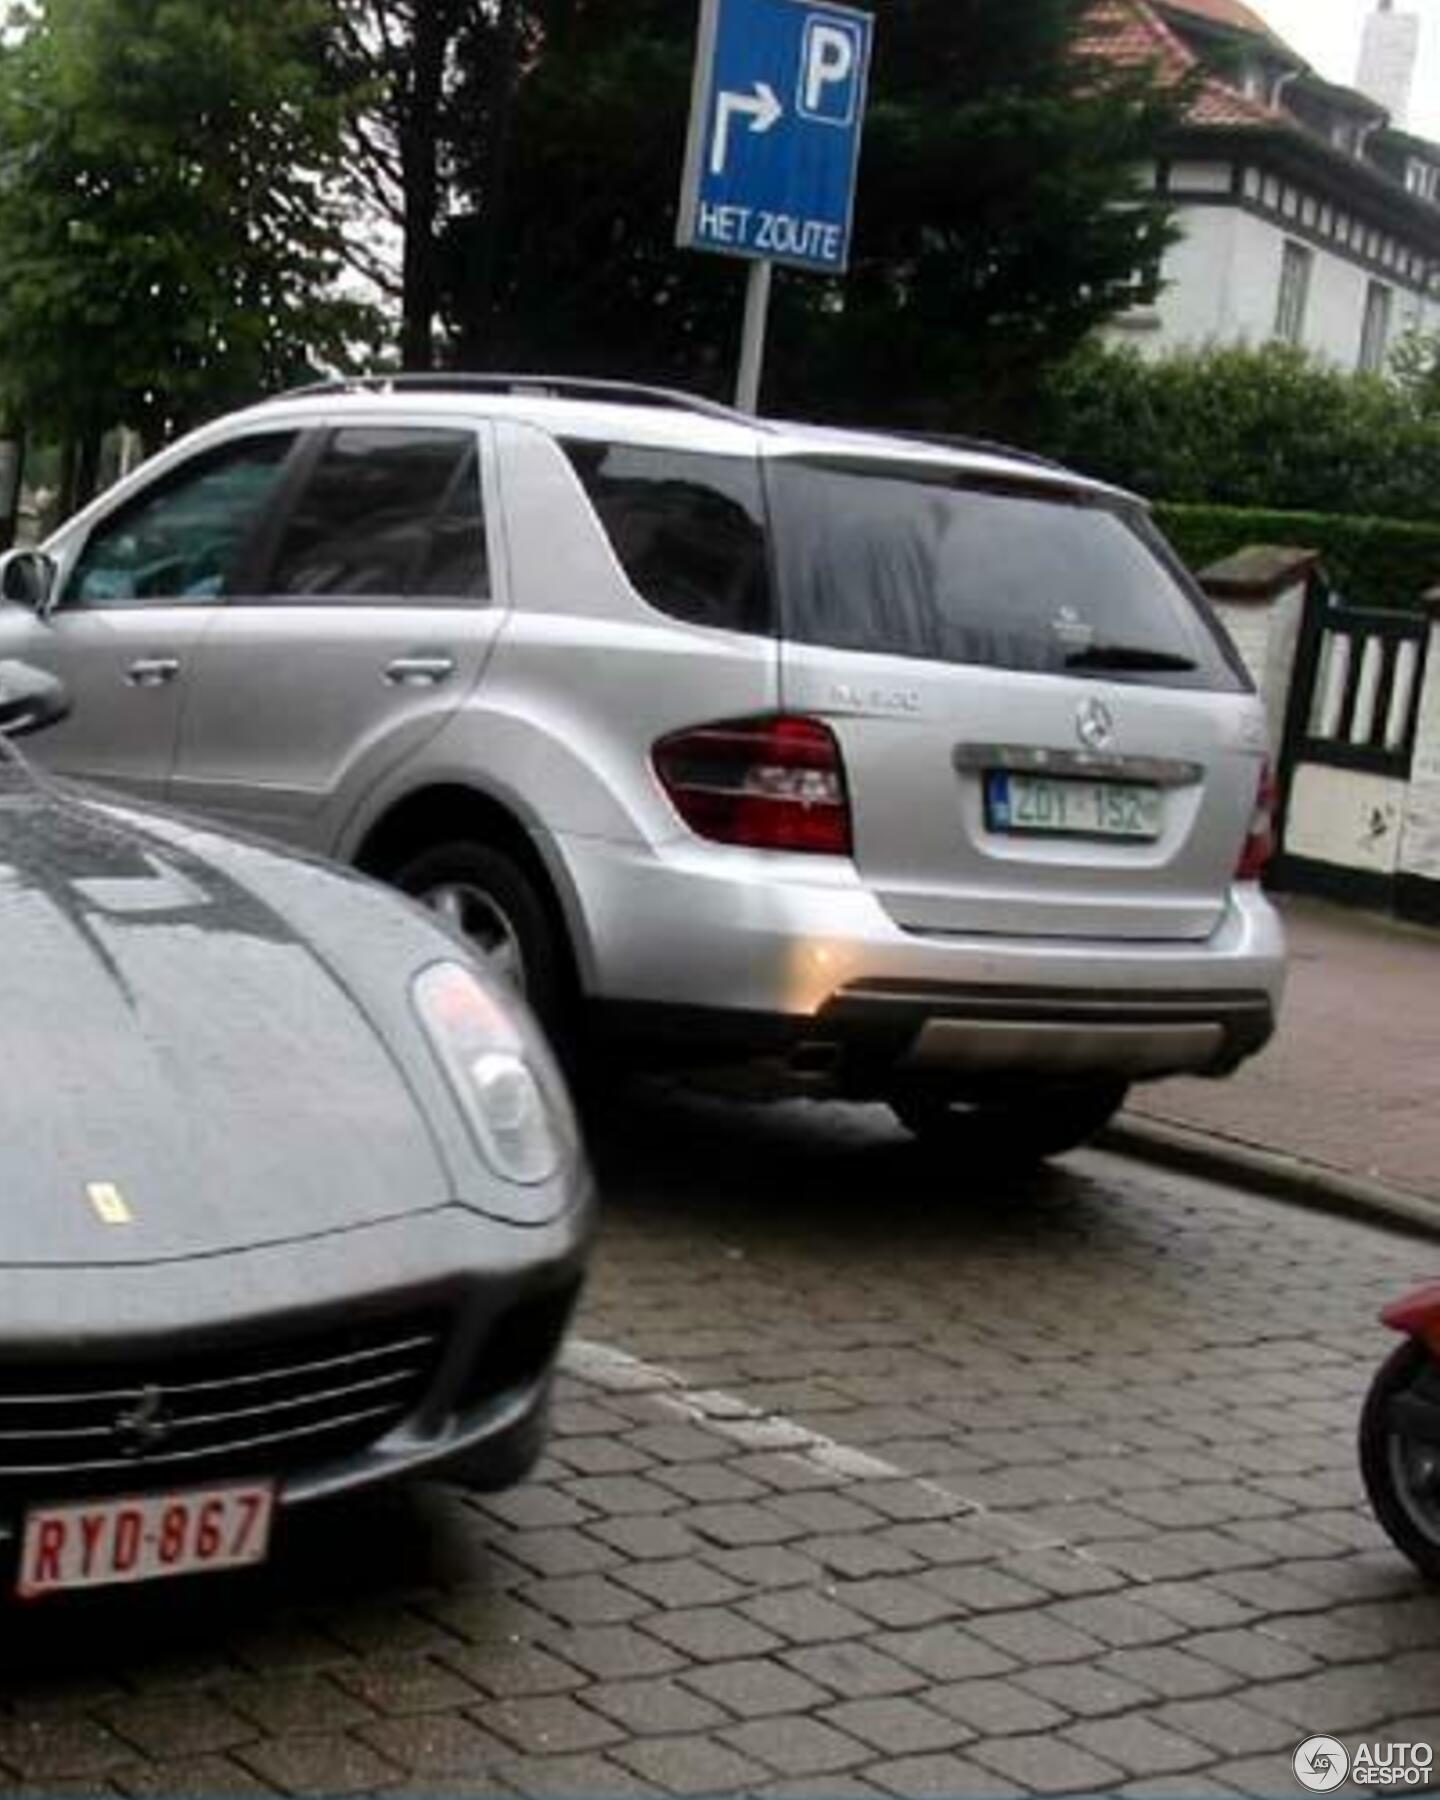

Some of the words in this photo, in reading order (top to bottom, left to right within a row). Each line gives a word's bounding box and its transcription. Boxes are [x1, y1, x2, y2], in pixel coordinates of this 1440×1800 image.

[806, 26, 851, 110] P
[698, 201, 750, 243] HET
[754, 214, 842, 259] ZOUTE
[35, 1495, 265, 1582] RYD-867
